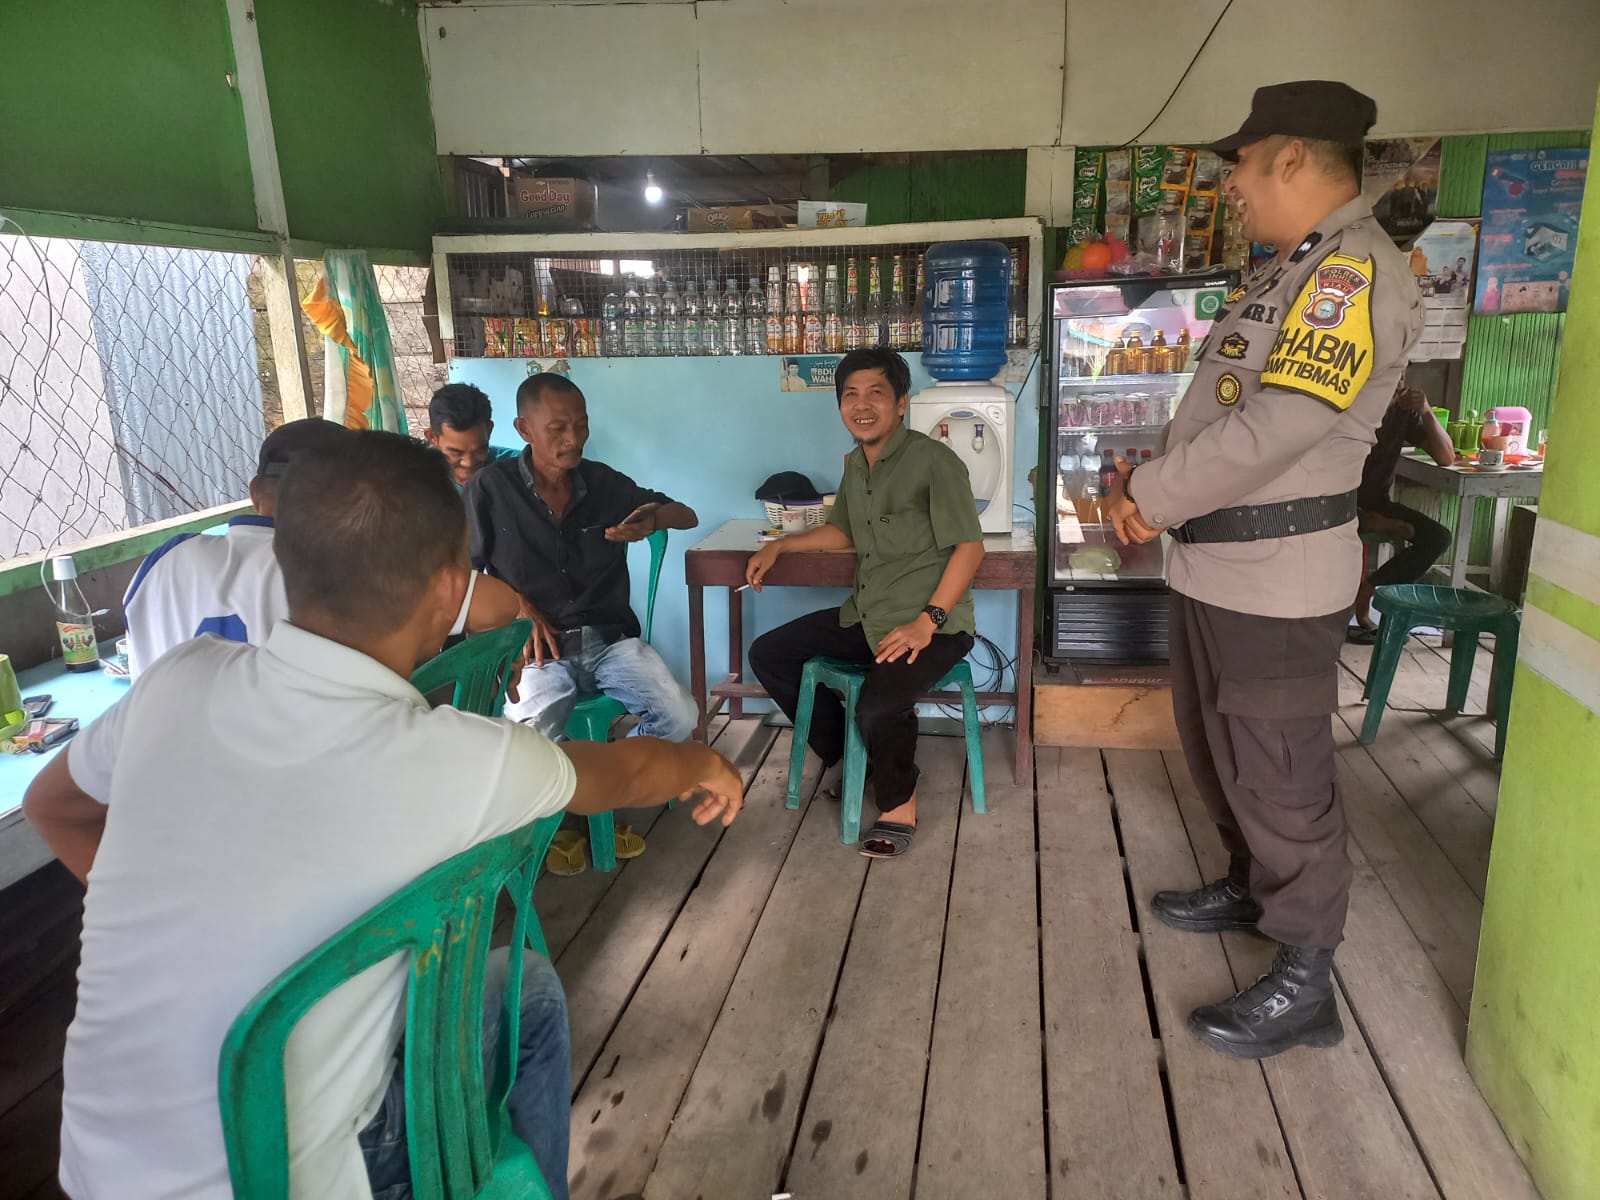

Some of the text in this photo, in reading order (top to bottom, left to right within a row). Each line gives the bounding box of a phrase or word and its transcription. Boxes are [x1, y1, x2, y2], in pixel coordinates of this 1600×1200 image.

[520, 189, 570, 204] Good Day
[1323, 267, 1361, 283] POLRES
[1323, 282, 1350, 292] RIAU
[811, 375, 836, 384] WAHI
